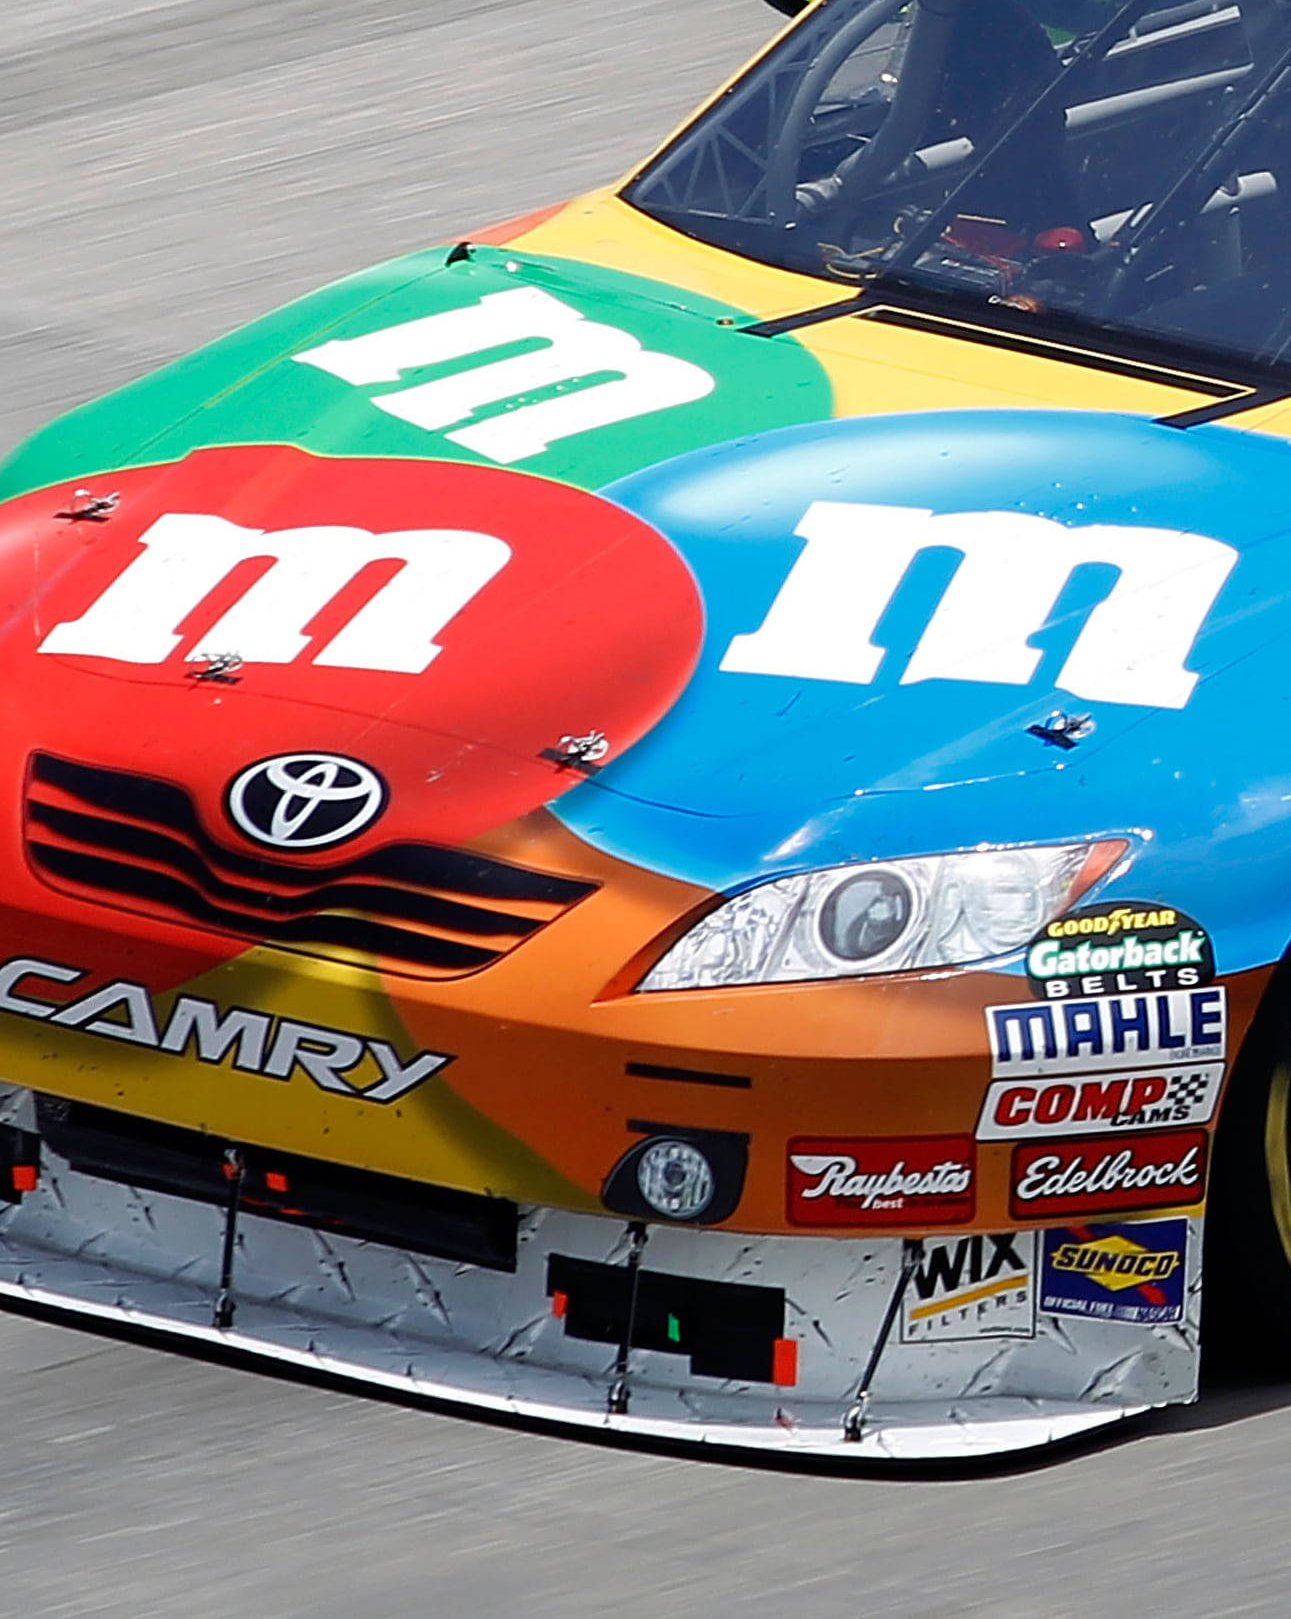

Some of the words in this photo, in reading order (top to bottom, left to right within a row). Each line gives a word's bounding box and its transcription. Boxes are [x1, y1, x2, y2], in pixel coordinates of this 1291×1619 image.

[289, 285, 716, 467] m
[37, 512, 513, 675] m
[718, 500, 1240, 710] m
[1047, 908, 1178, 937] GOODYEAR
[1029, 931, 1207, 979] Gatorback
[1045, 967, 1200, 999] BELTS
[0, 959, 452, 1101] CAMRY
[994, 990, 1222, 1062] MAHLE
[994, 1076, 1167, 1127] COMP
[1110, 1104, 1191, 1127] CAMS
[1016, 1146, 1199, 1201] Edelbrock
[903, 1232, 1027, 1300] WIX
[1055, 1246, 1176, 1278] SUNOCO
[907, 1289, 1028, 1337] FILTERS
